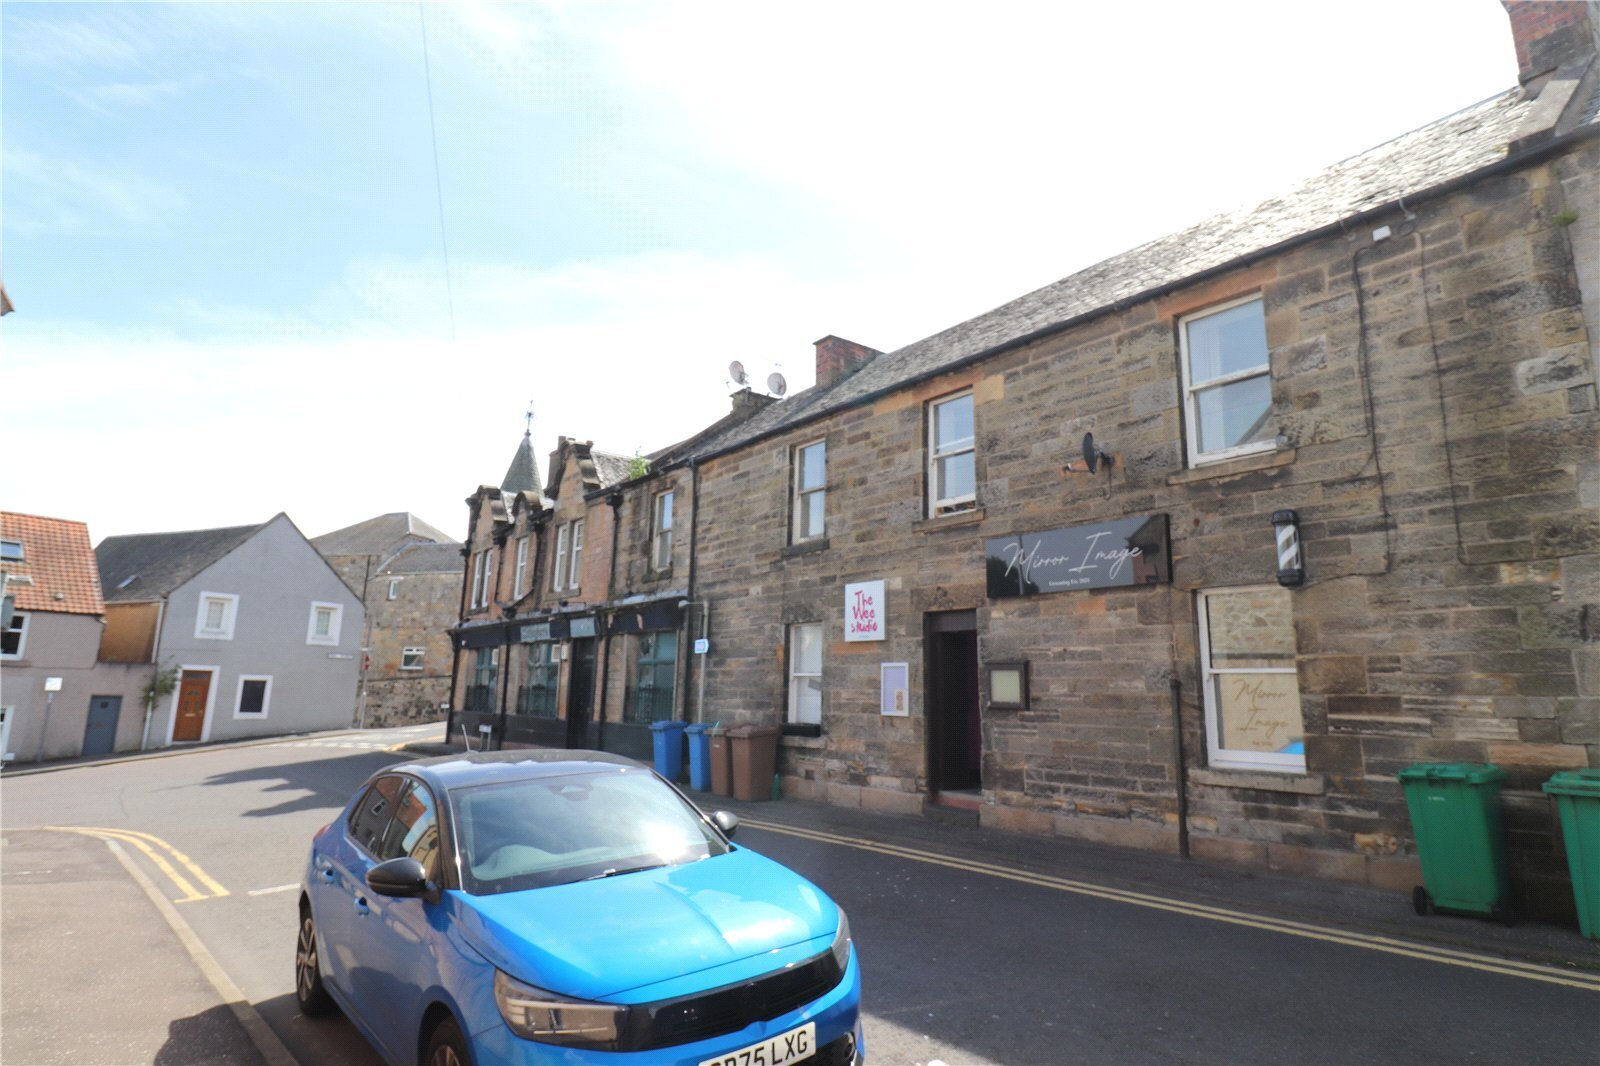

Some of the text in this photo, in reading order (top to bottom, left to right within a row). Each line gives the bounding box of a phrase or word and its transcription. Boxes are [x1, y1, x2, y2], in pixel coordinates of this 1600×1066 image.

[1002, 531, 1143, 585] Mirror Image
[852, 606, 876, 621] Wee
[854, 589, 873, 608] The
[1232, 678, 1287, 710] Mirror
[1235, 707, 1289, 740] Image
[771, 1029, 808, 1066] LXG
